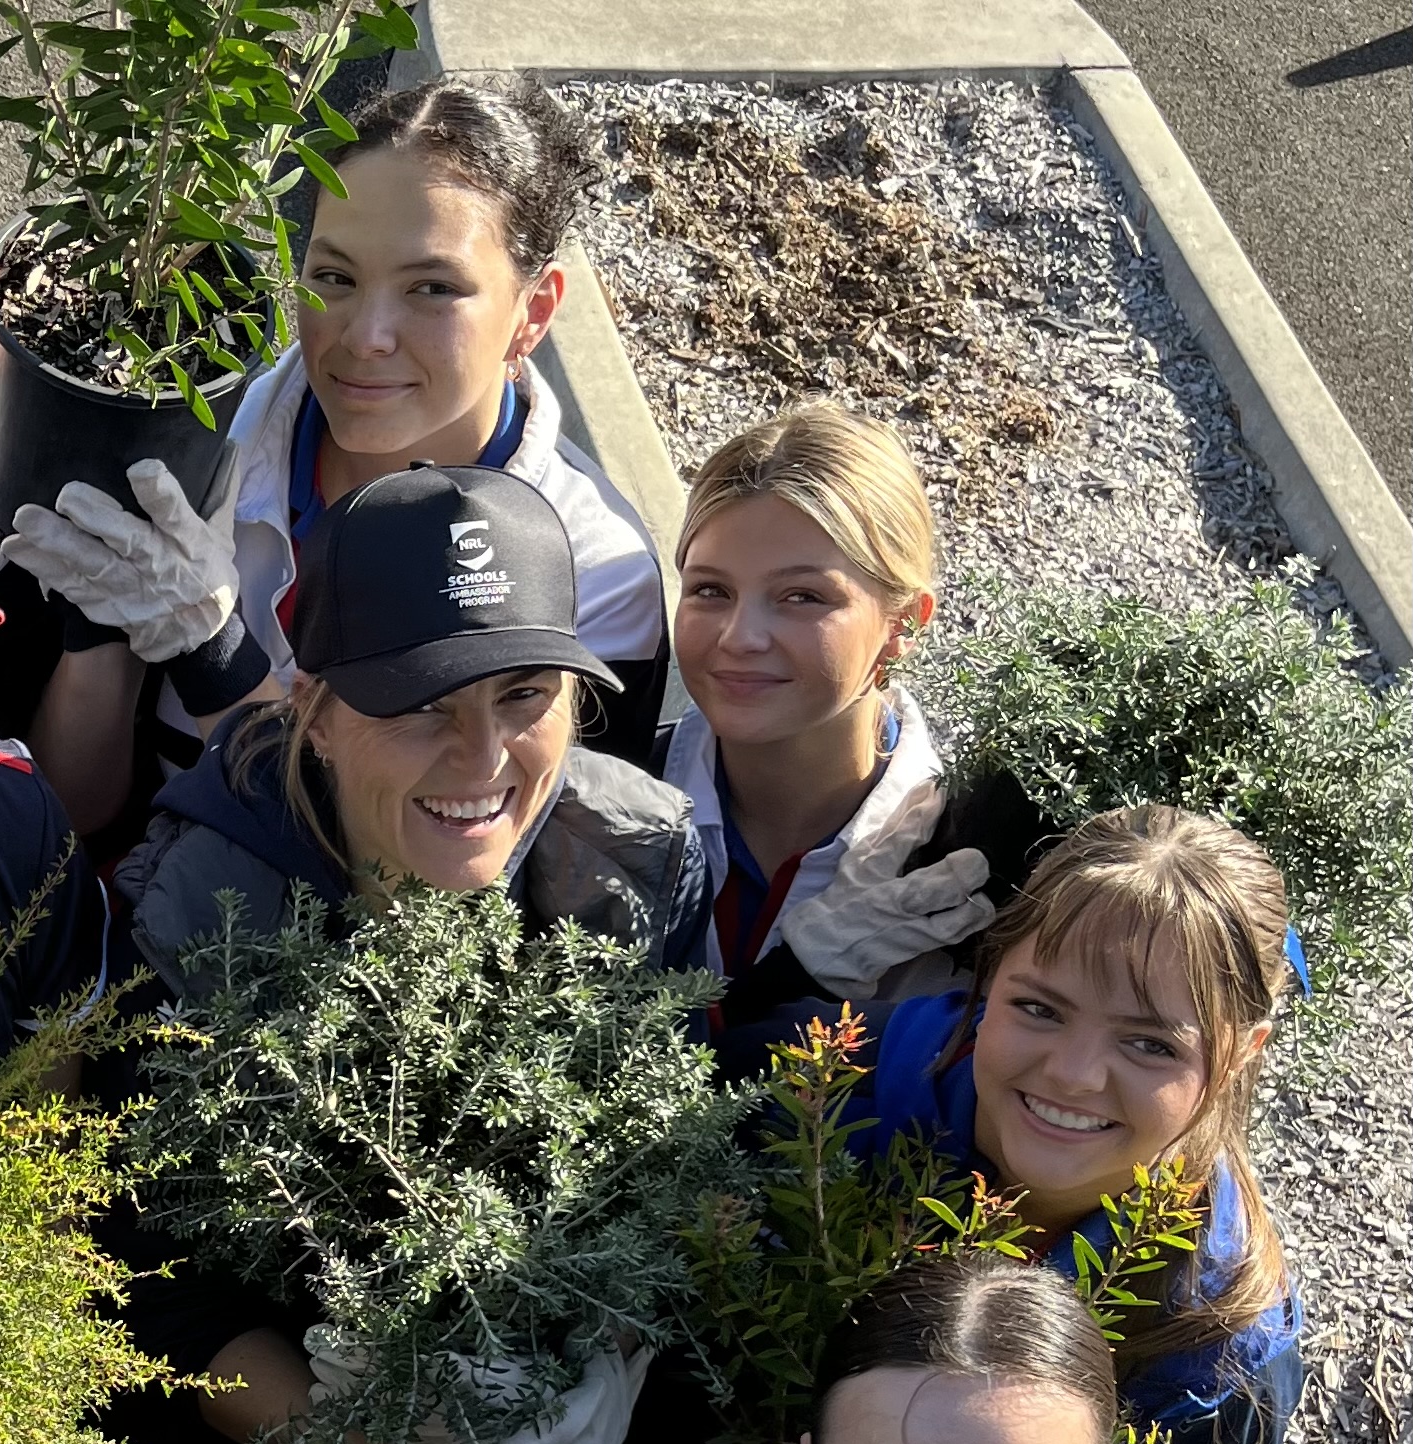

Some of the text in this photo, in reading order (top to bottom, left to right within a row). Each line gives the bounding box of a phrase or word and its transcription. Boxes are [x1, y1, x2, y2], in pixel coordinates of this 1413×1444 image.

[458, 538, 486, 551] NRL
[447, 570, 507, 587] SCHOOLS
[448, 585, 511, 601] AMBASSADOR
[458, 595, 505, 608] PROGRAM
